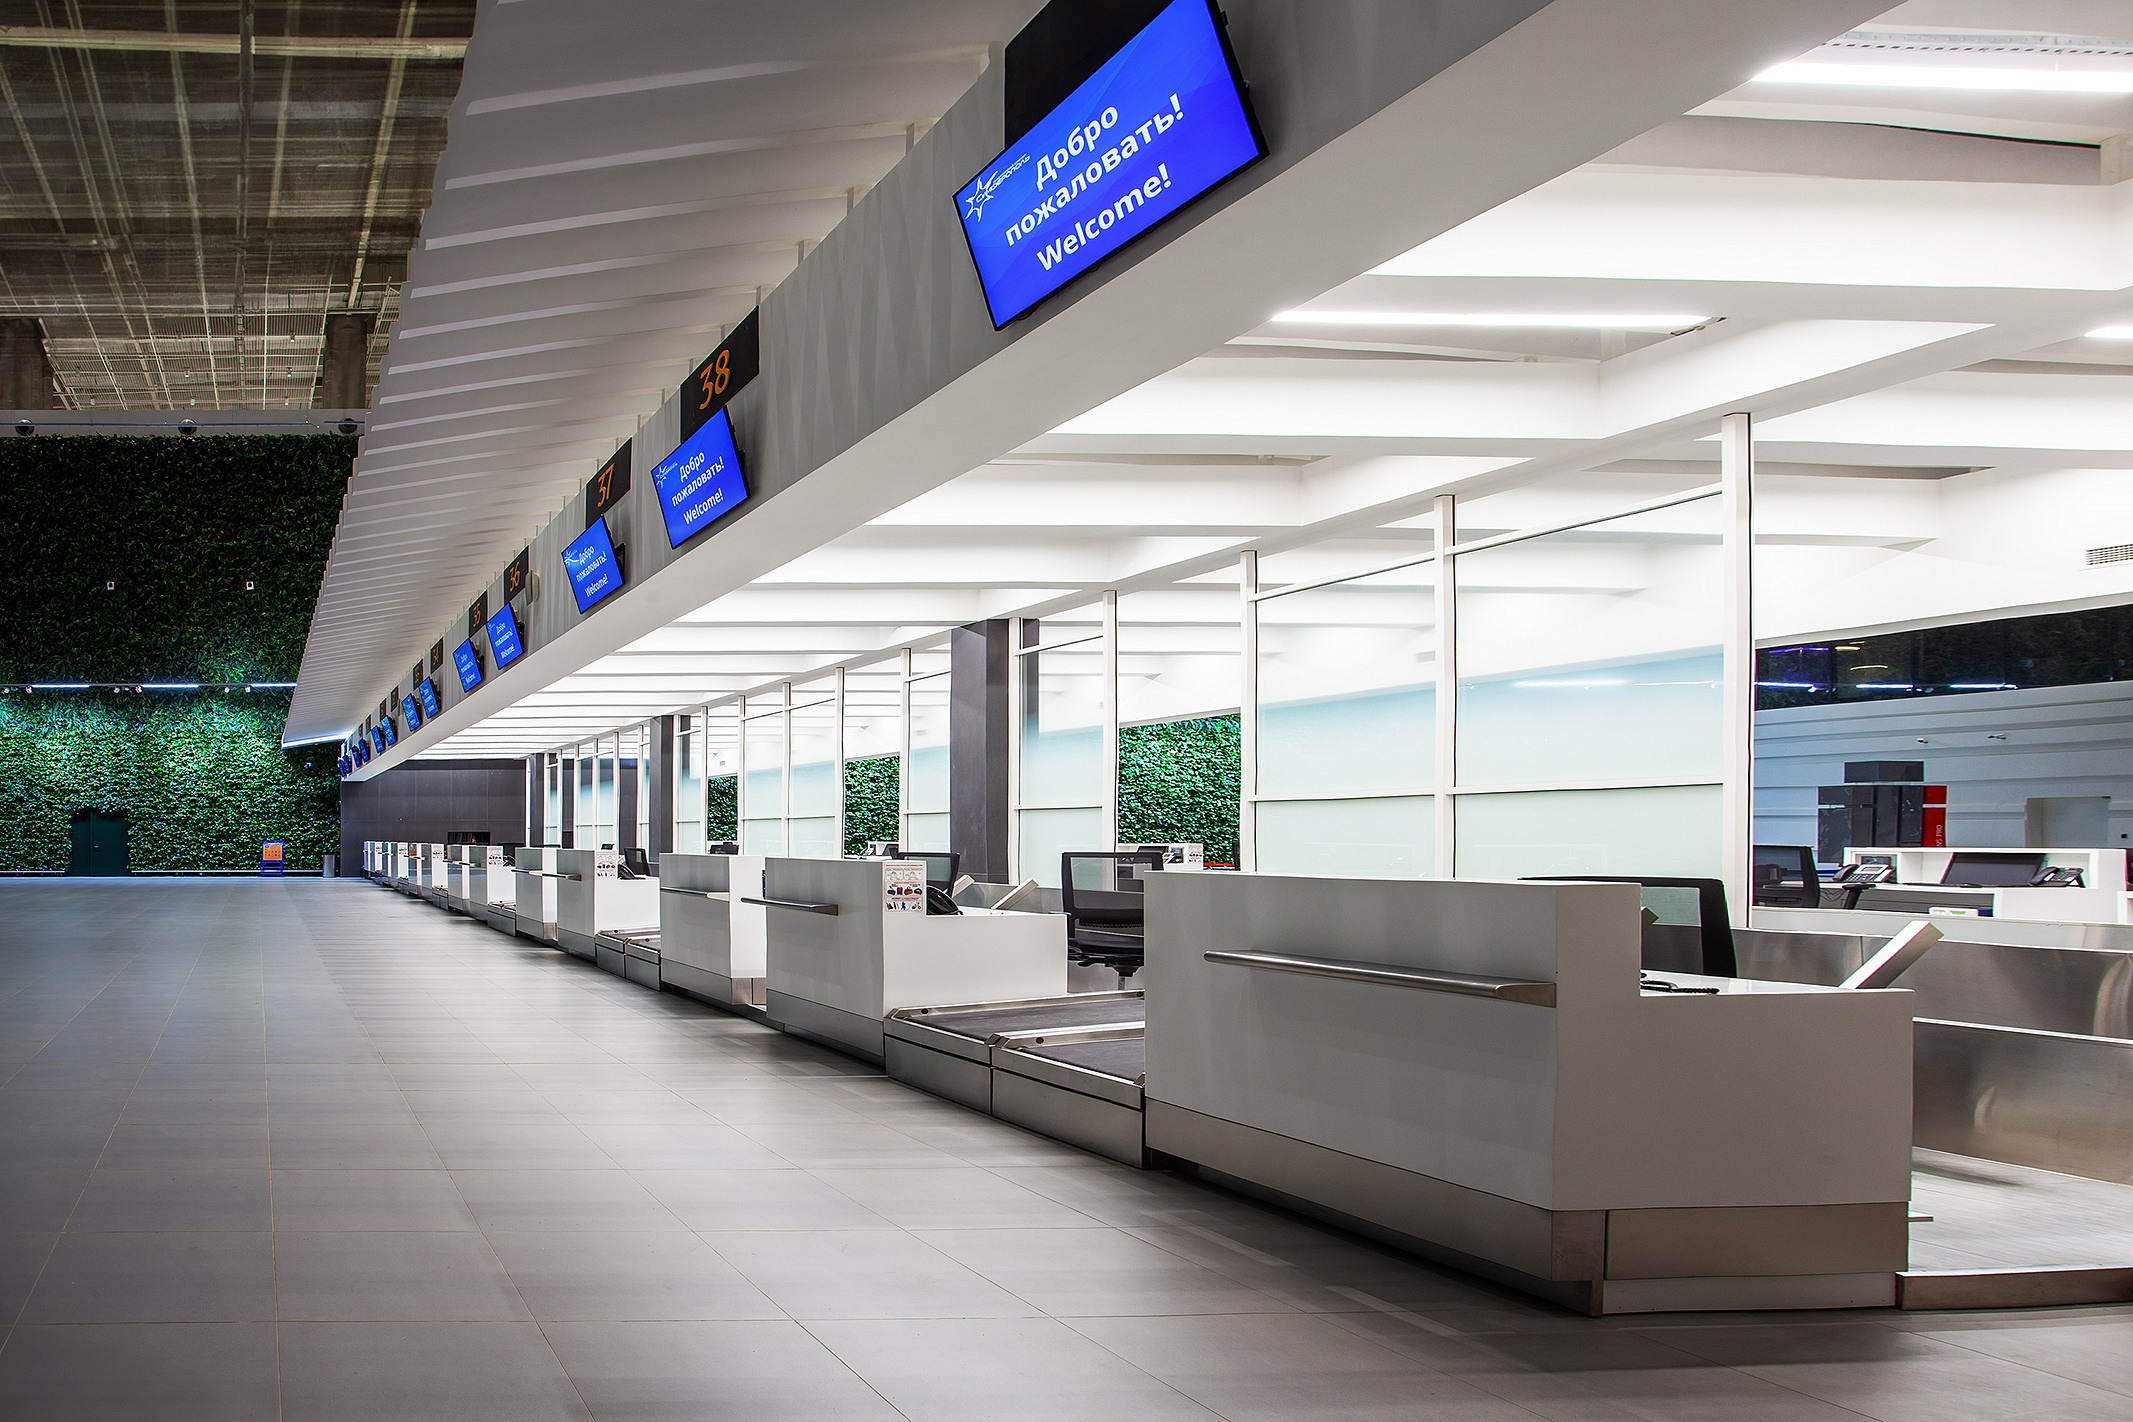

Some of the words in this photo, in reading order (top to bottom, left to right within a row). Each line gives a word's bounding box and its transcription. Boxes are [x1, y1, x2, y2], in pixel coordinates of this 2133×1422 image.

[1004, 93, 1184, 247] пожаловать!
[1035, 106, 1118, 191] Добро
[1036, 163, 1172, 271] Welcome!
[699, 349, 731, 410] 38
[597, 463, 614, 507] 37
[671, 456, 724, 507] пожаловать!
[679, 452, 705, 483] Добро
[683, 487, 724, 525] Welcome!
[509, 561, 520, 592] 36
[473, 602, 481, 627] 35
